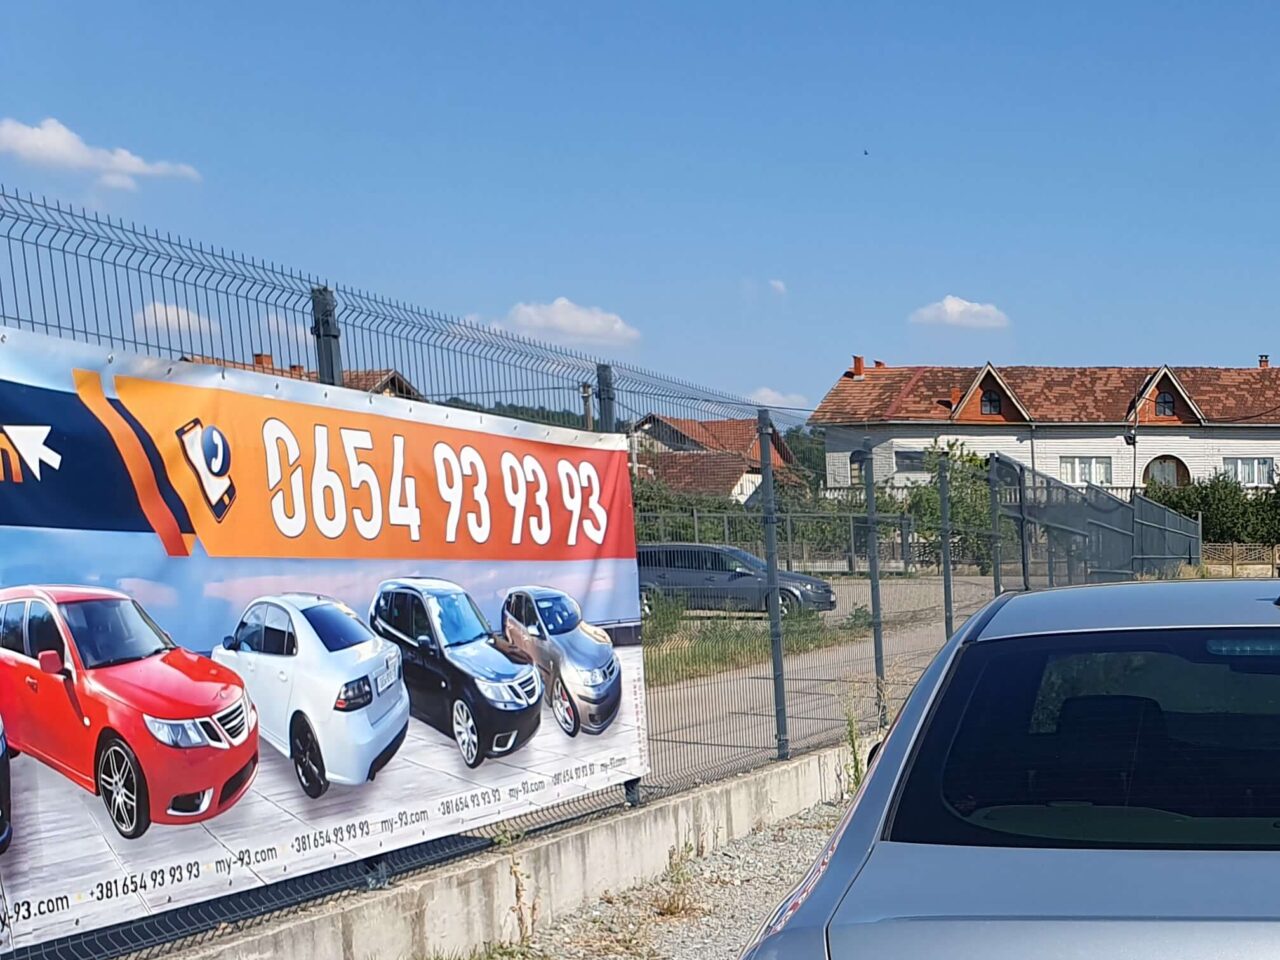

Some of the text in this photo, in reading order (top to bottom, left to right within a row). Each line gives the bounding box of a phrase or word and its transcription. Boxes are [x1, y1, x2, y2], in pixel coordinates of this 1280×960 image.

[262, 417, 608, 546] 0654 93 93 93
[0, 895, 70, 933] y-93.com
[89, 879, 119, 901] +381
[122, 872, 147, 895] 654
[151, 869, 165, 889] 93
[169, 865, 183, 884] 93
[186, 861, 200, 881] 93
[215, 847, 277, 875] my-93.com
[291, 834, 311, 853] +381
[313, 829, 331, 849] 654
[333, 827, 344, 843] 93
[346, 823, 357, 840] 93
[359, 820, 370, 837] 93
[381, 810, 429, 833] my-93.com
[455, 796, 470, 812] 654
[470, 793, 480, 808] 93
[481, 791, 491, 806] 93
[491, 788, 501, 802] 93
[508, 780, 546, 800] my-93.com
